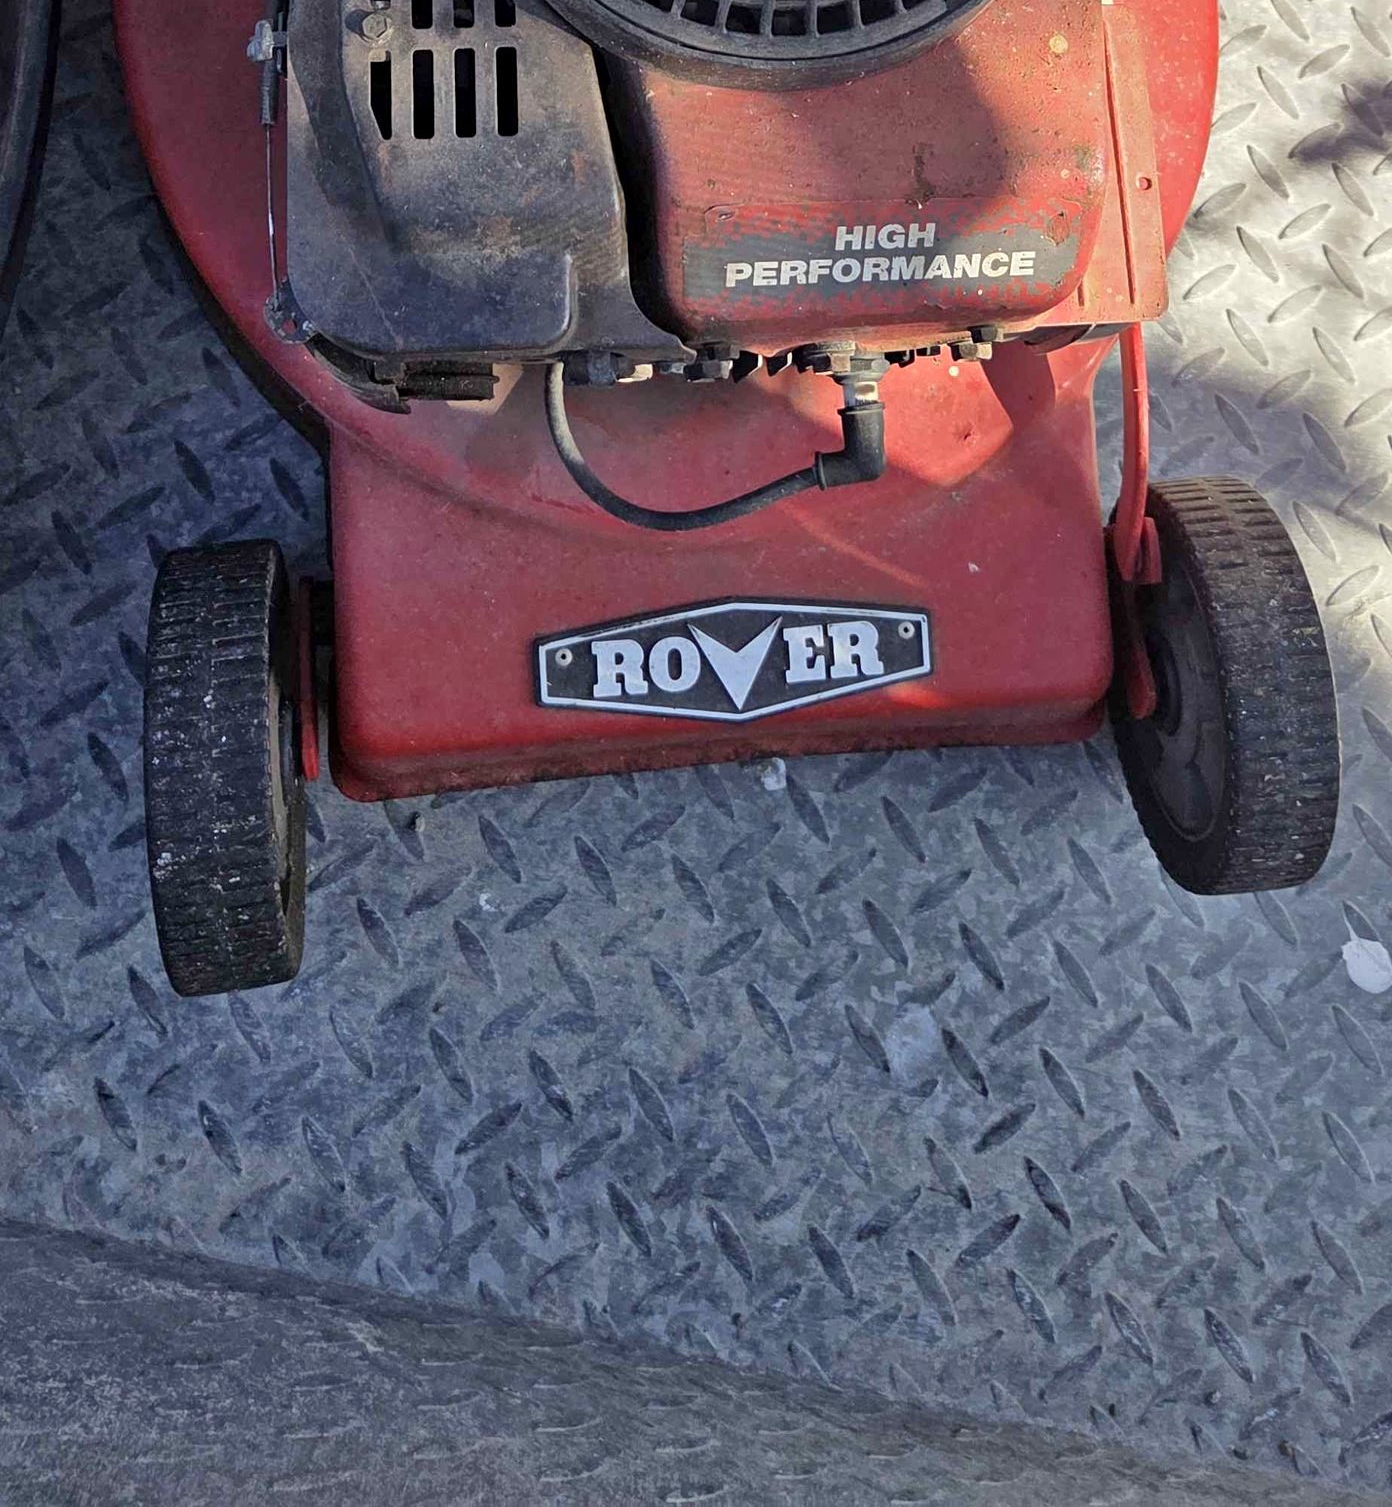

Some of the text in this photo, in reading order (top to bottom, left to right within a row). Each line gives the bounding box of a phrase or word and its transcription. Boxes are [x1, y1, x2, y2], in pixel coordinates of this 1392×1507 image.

[834, 222, 936, 251] HIGH
[724, 251, 1036, 288] PERFORMANCE
[591, 616, 884, 711] ROVER
